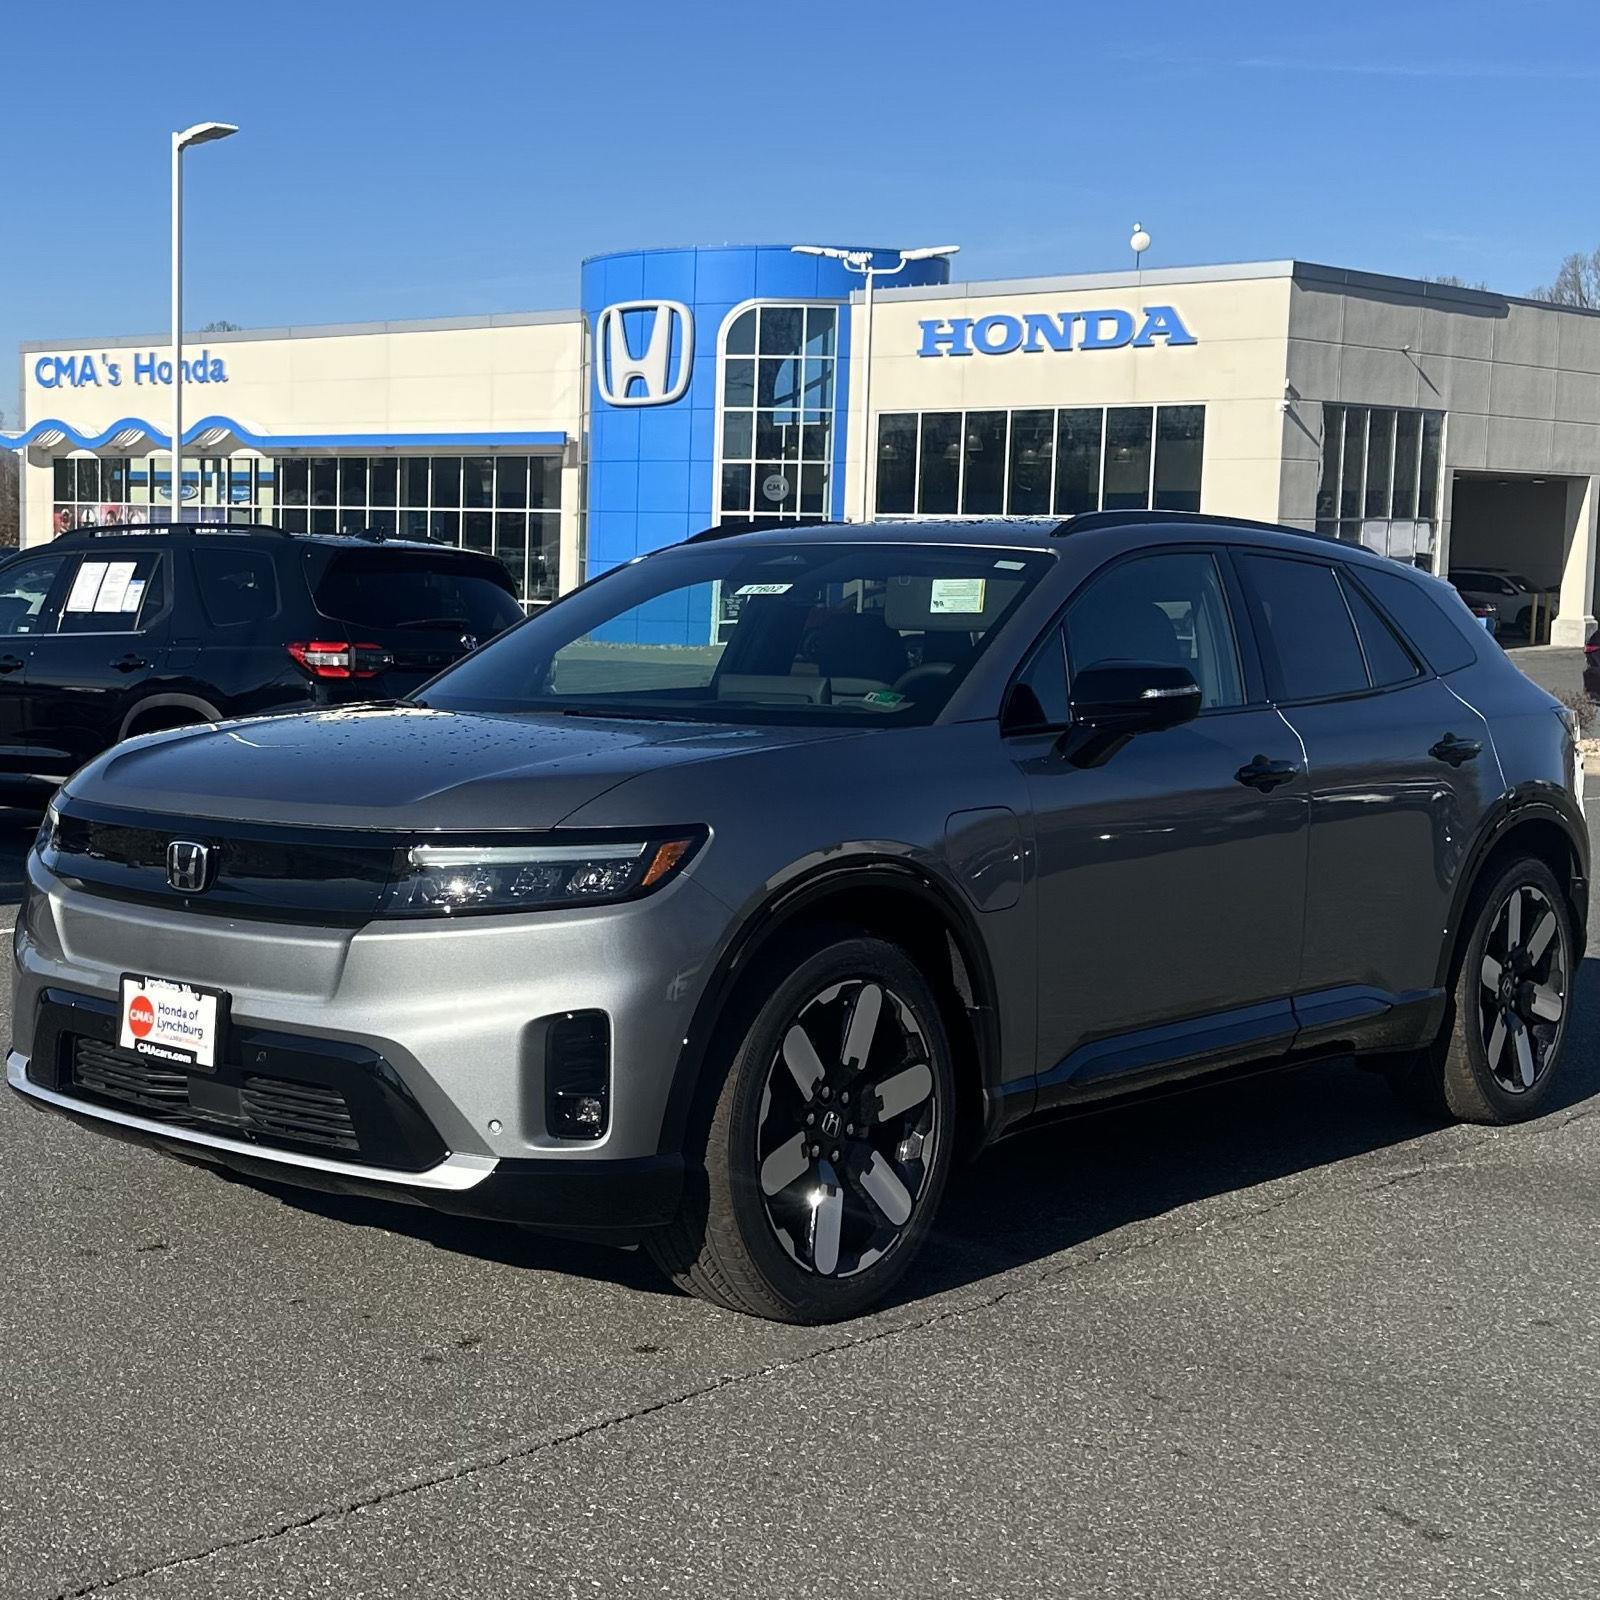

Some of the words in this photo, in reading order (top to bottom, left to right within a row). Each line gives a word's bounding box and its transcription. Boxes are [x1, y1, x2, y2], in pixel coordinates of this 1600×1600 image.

[917, 306, 1198, 357] HONDA
[35, 353, 122, 389] CMA's
[134, 350, 229, 386] Honda
[158, 1002, 188, 1018] Honda
[188, 1009, 199, 1021] of
[157, 1018, 203, 1039] Lynchburg
